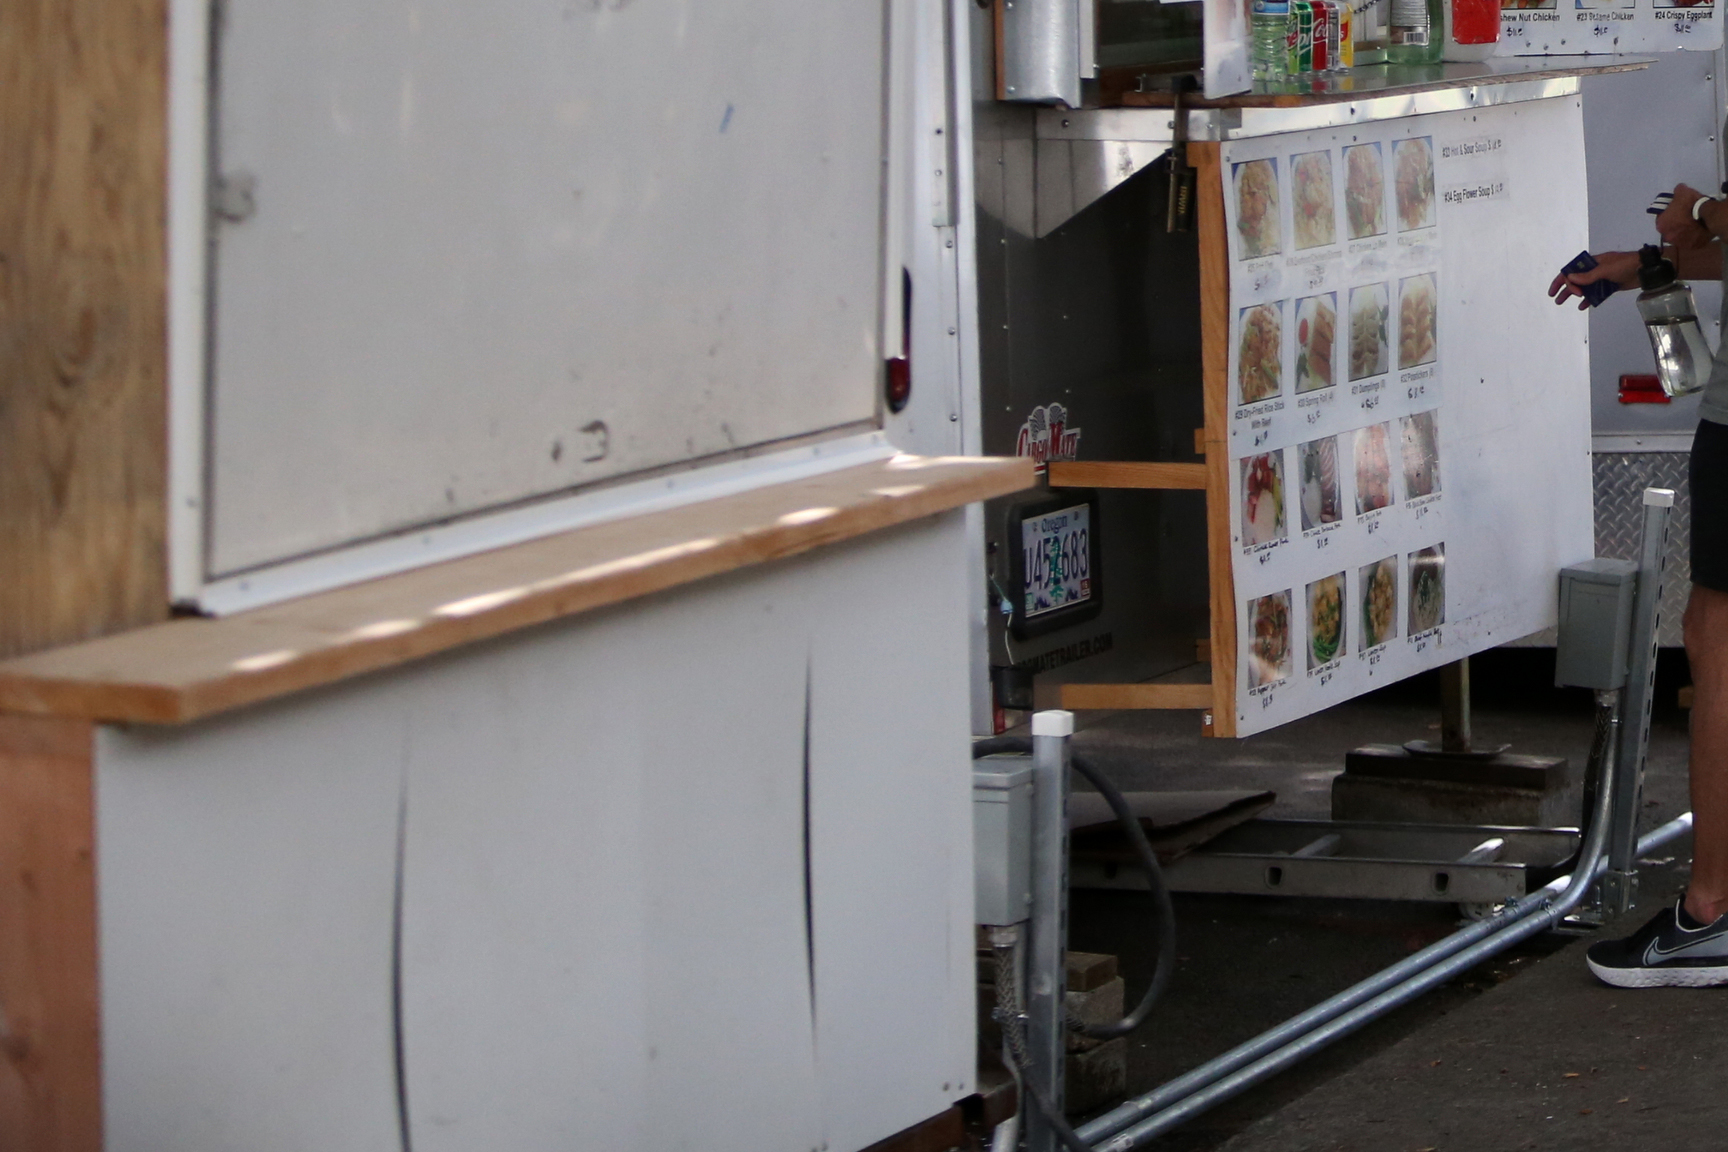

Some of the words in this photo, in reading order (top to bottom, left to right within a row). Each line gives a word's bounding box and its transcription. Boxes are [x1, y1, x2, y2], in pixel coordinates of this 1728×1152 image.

[1518, 12, 1532, 22] Nut
[1533, 12, 1560, 22] Chicken
[1577, 12, 1588, 21] #23
[1612, 12, 1634, 21] Chicken
[1655, 11, 1665, 19] #24
[1667, 11, 1685, 22] Crispy
[1687, 11, 1712, 22] Eggplant
[1453, 190, 1462, 204] Egg
[1463, 188, 1477, 200] Flower
[1478, 186, 1490, 199] Soup
[1359, 381, 1380, 394] Dumplings
[1264, 403, 1273, 414] Rice
[1273, 402, 1284, 412] Stick
[1305, 395, 1319, 408] Spring
[1042, 516, 1068, 534] Oregon
[1024, 528, 1087, 590] U452683
